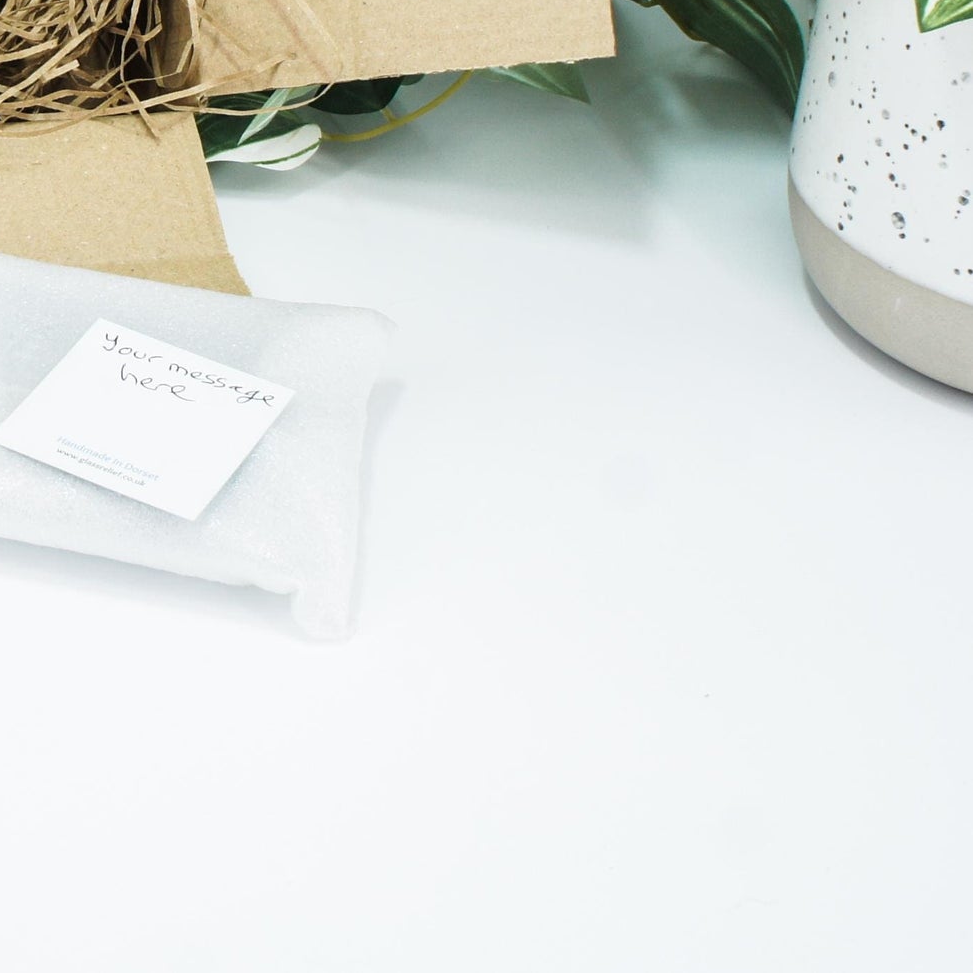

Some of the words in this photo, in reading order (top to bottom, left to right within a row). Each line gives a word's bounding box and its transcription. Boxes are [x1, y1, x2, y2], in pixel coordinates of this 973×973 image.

[120, 363, 195, 402] here
[169, 363, 275, 407] message
[56, 448, 146, 486] www.glassrelief.co.uk
[57, 436, 112, 462] Handmade
[124, 462, 160, 482] Dorset
